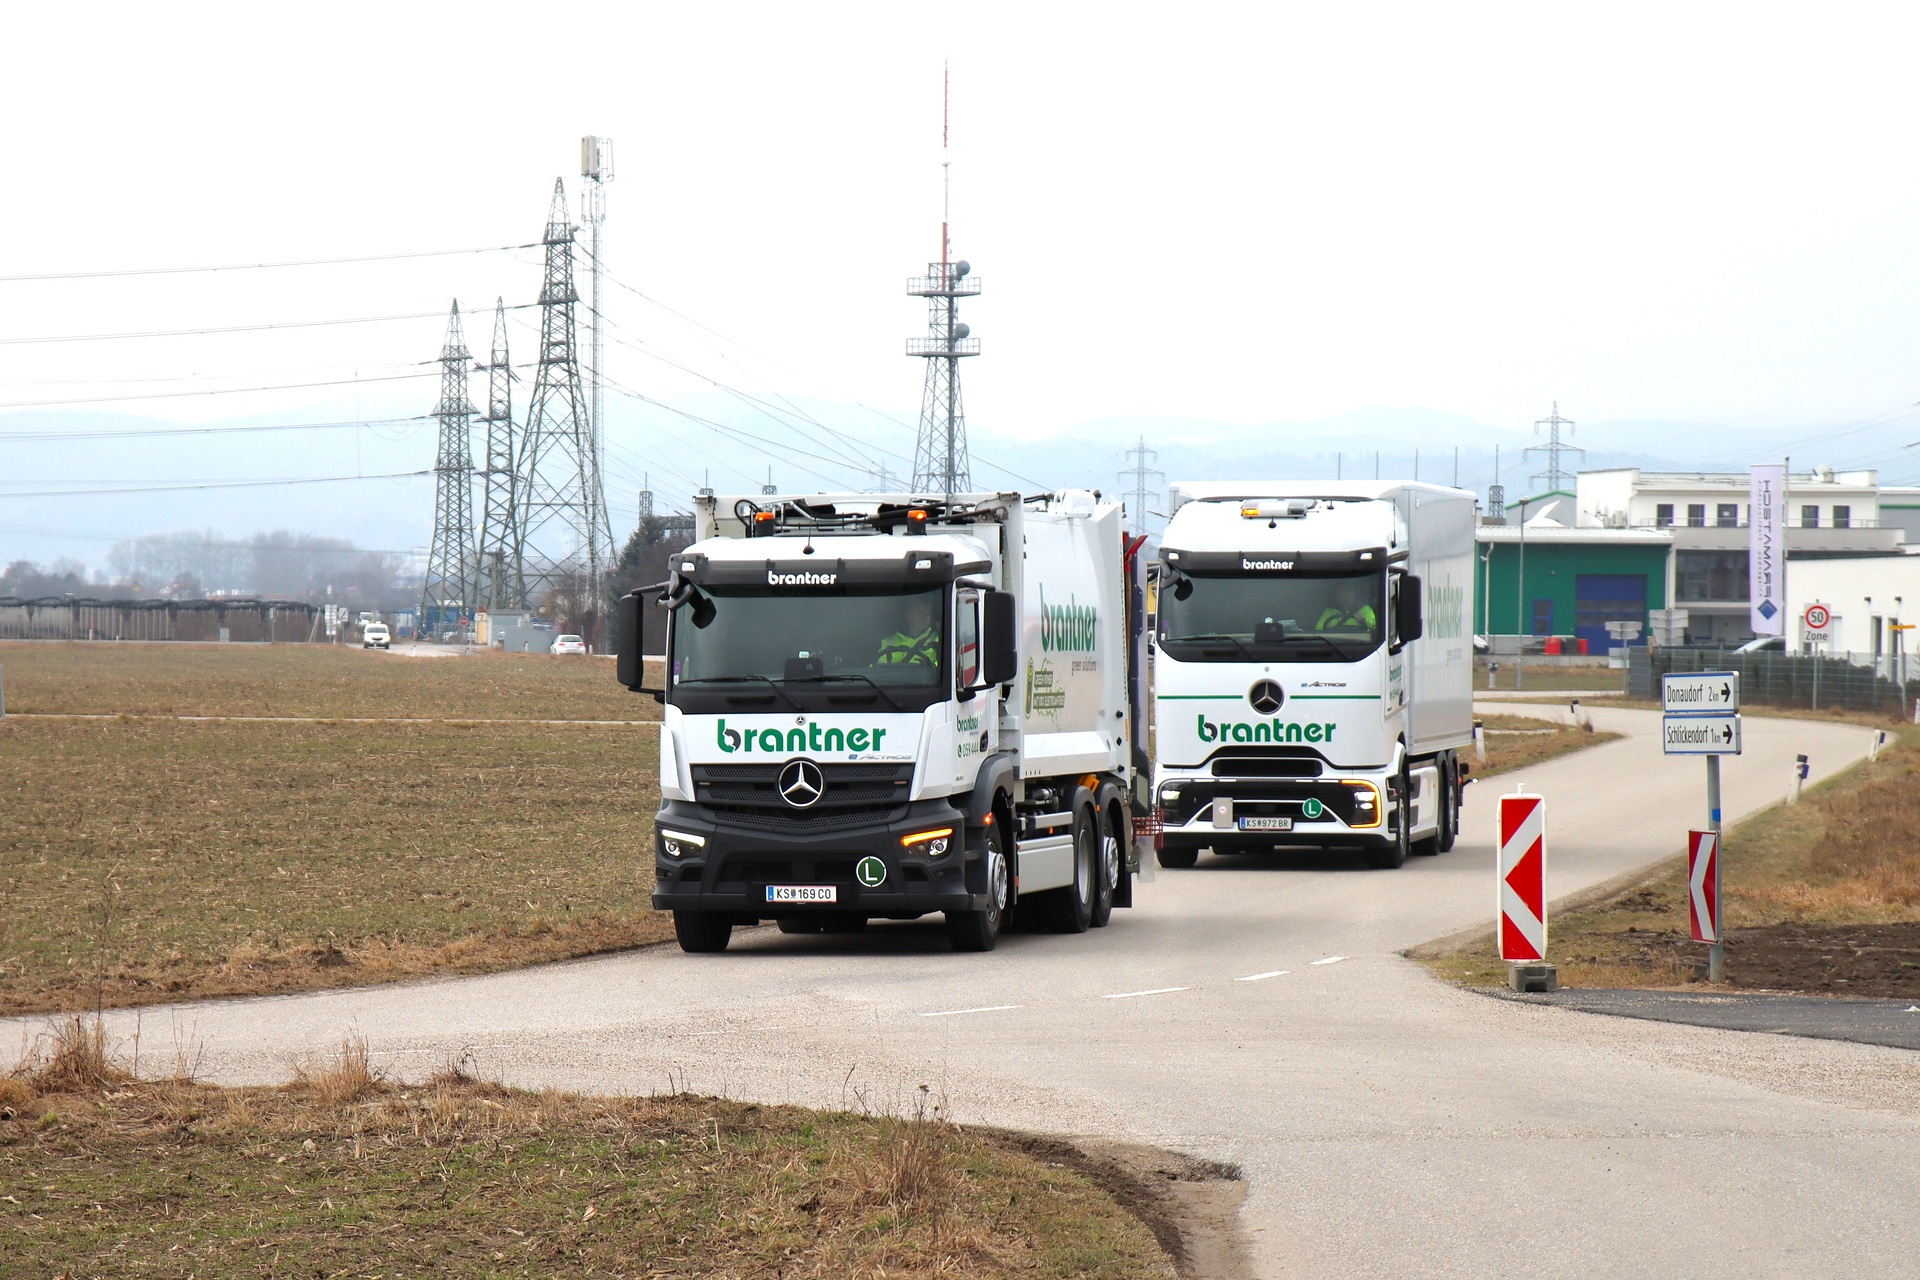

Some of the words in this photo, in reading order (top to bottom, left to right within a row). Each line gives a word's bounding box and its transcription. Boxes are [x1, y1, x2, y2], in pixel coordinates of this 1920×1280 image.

[1243, 558, 1294, 570] brantner
[768, 570, 837, 585] brantner
[1039, 582, 1097, 652] brantner
[1811, 611, 1824, 623] 50
[1805, 631, 1828, 641] Zone
[1667, 684, 1703, 702] Donaudorf
[717, 718, 887, 754] brantner
[1198, 714, 1337, 743] brantner
[1667, 725, 1709, 744] Schlickendorf
[1308, 802, 1317, 814] L
[1246, 819, 1257, 828] KS
[1262, 819, 1277, 828] 972
[1278, 819, 1289, 828] BR
[864, 863, 878, 881] L
[776, 888, 790, 899] KS
[798, 888, 816, 899] 169
